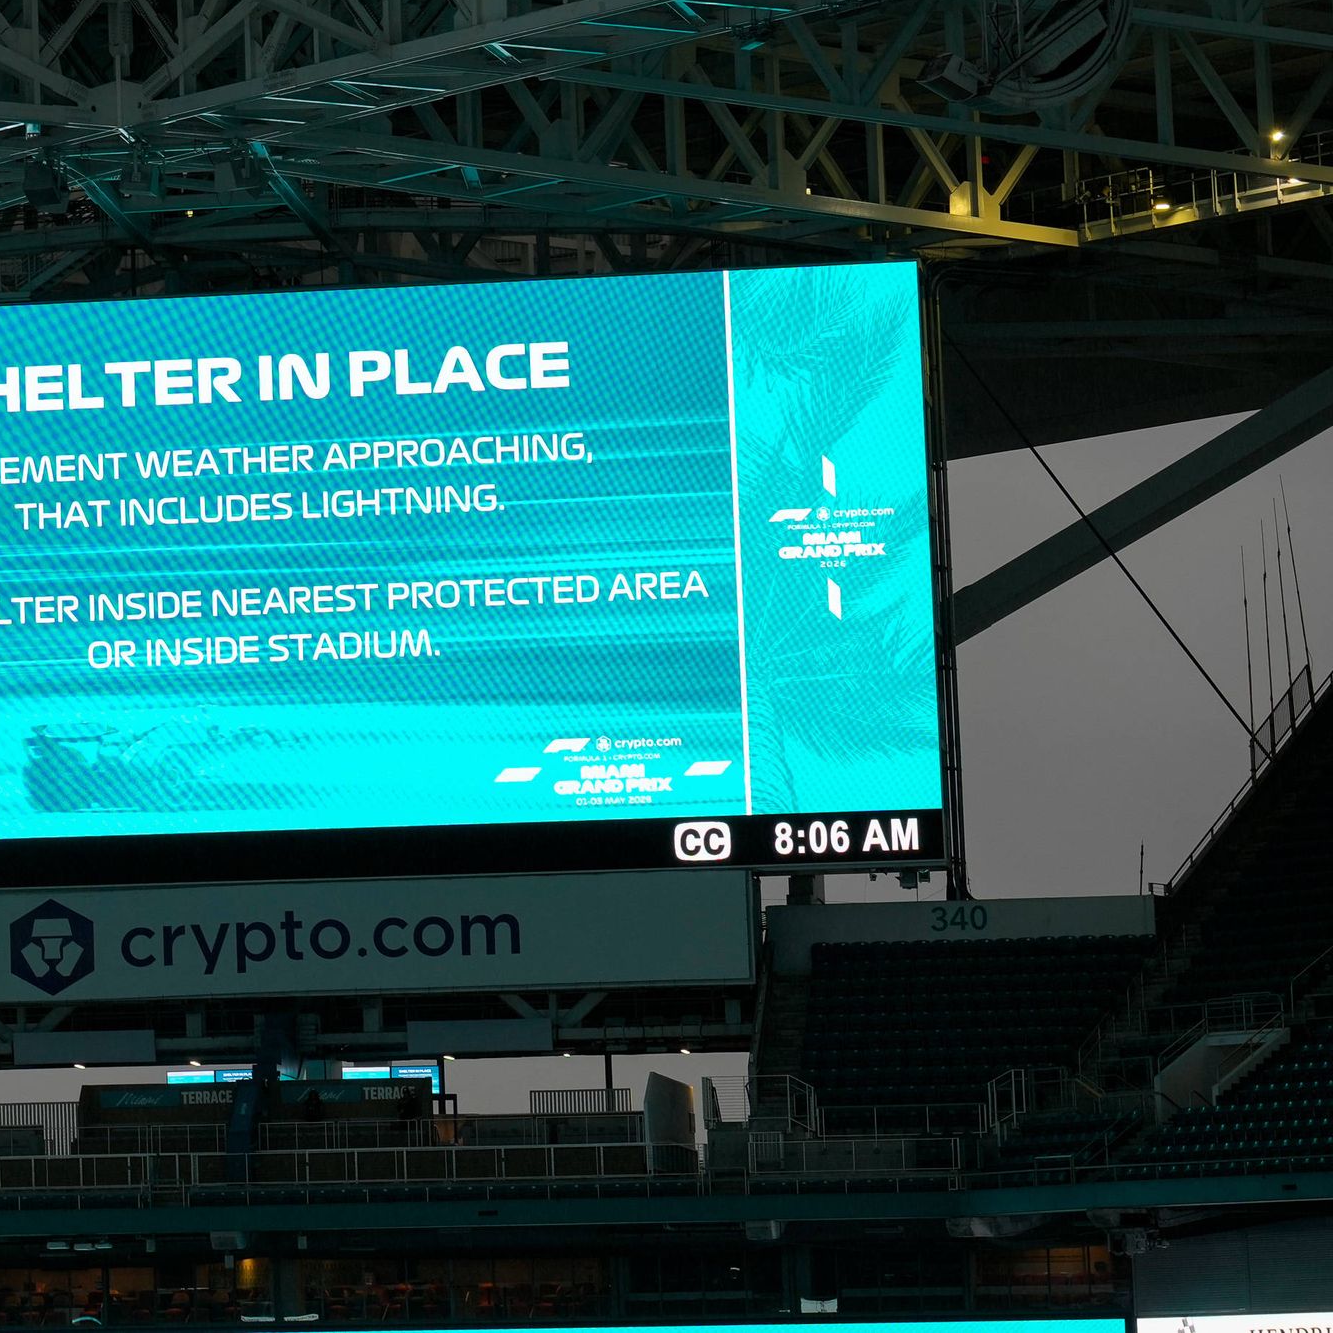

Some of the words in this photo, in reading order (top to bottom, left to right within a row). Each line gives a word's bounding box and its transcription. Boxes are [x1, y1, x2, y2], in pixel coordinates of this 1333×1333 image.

[259, 353, 330, 401] IN
[348, 342, 570, 397] PLACE
[135, 444, 314, 479] WEATHER
[323, 432, 593, 470] APPROACHING,
[14, 500, 111, 529] THAT
[120, 493, 293, 526] INCLUDES
[302, 483, 505, 519] LIGHTNING.
[833, 507, 895, 519] crypto.com
[778, 545, 842, 559] GRAND
[844, 543, 886, 556] PRIX
[802, 531, 861, 545] MIAMI
[89, 590, 202, 622] INSIDE
[212, 583, 379, 617] NEAREST
[387, 575, 600, 610] PROTECTED
[608, 570, 709, 602] AREA
[88, 640, 136, 669] OR
[146, 635, 260, 667] INSIDE
[268, 629, 441, 663] STADIUM.
[614, 737, 682, 750] crypto.com
[580, 764, 645, 779] MIAMI
[553, 779, 624, 795] GRAND
[626, 777, 673, 793] PRIX
[605, 796, 625, 805] MAY
[680, 828, 725, 856] CC
[774, 821, 850, 855] 8:06
[862, 818, 920, 852] AM
[930, 904, 988, 932] 340
[121, 910, 521, 975] crypto.com
[181, 1090, 233, 1105] TERRACE
